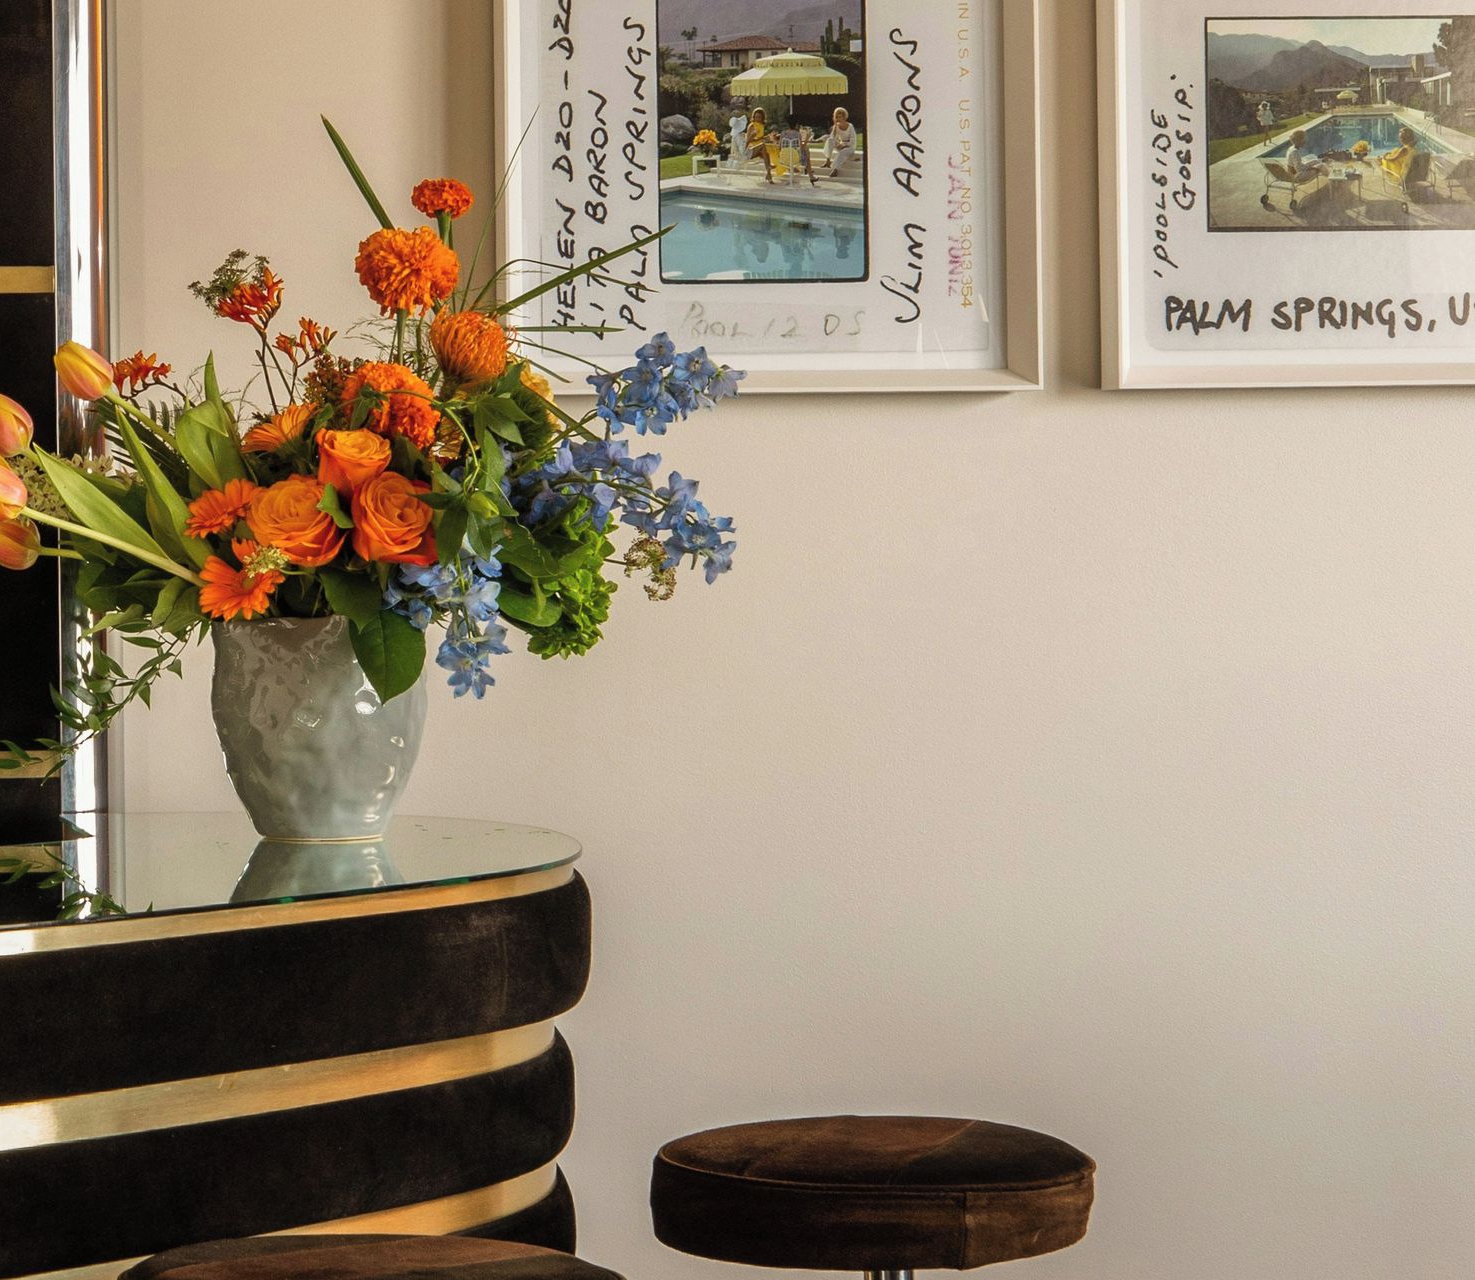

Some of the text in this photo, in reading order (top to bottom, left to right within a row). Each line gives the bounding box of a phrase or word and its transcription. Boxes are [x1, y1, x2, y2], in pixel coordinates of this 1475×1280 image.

[957, 1, 969, 20] IN
[584, 89, 610, 225] BARON
[622, 16, 652, 201] SPRINGS
[889, 27, 923, 197] AARONS
[1164, 295, 1253, 336] PALM
[1270, 296, 1437, 339] SPRINGS,
